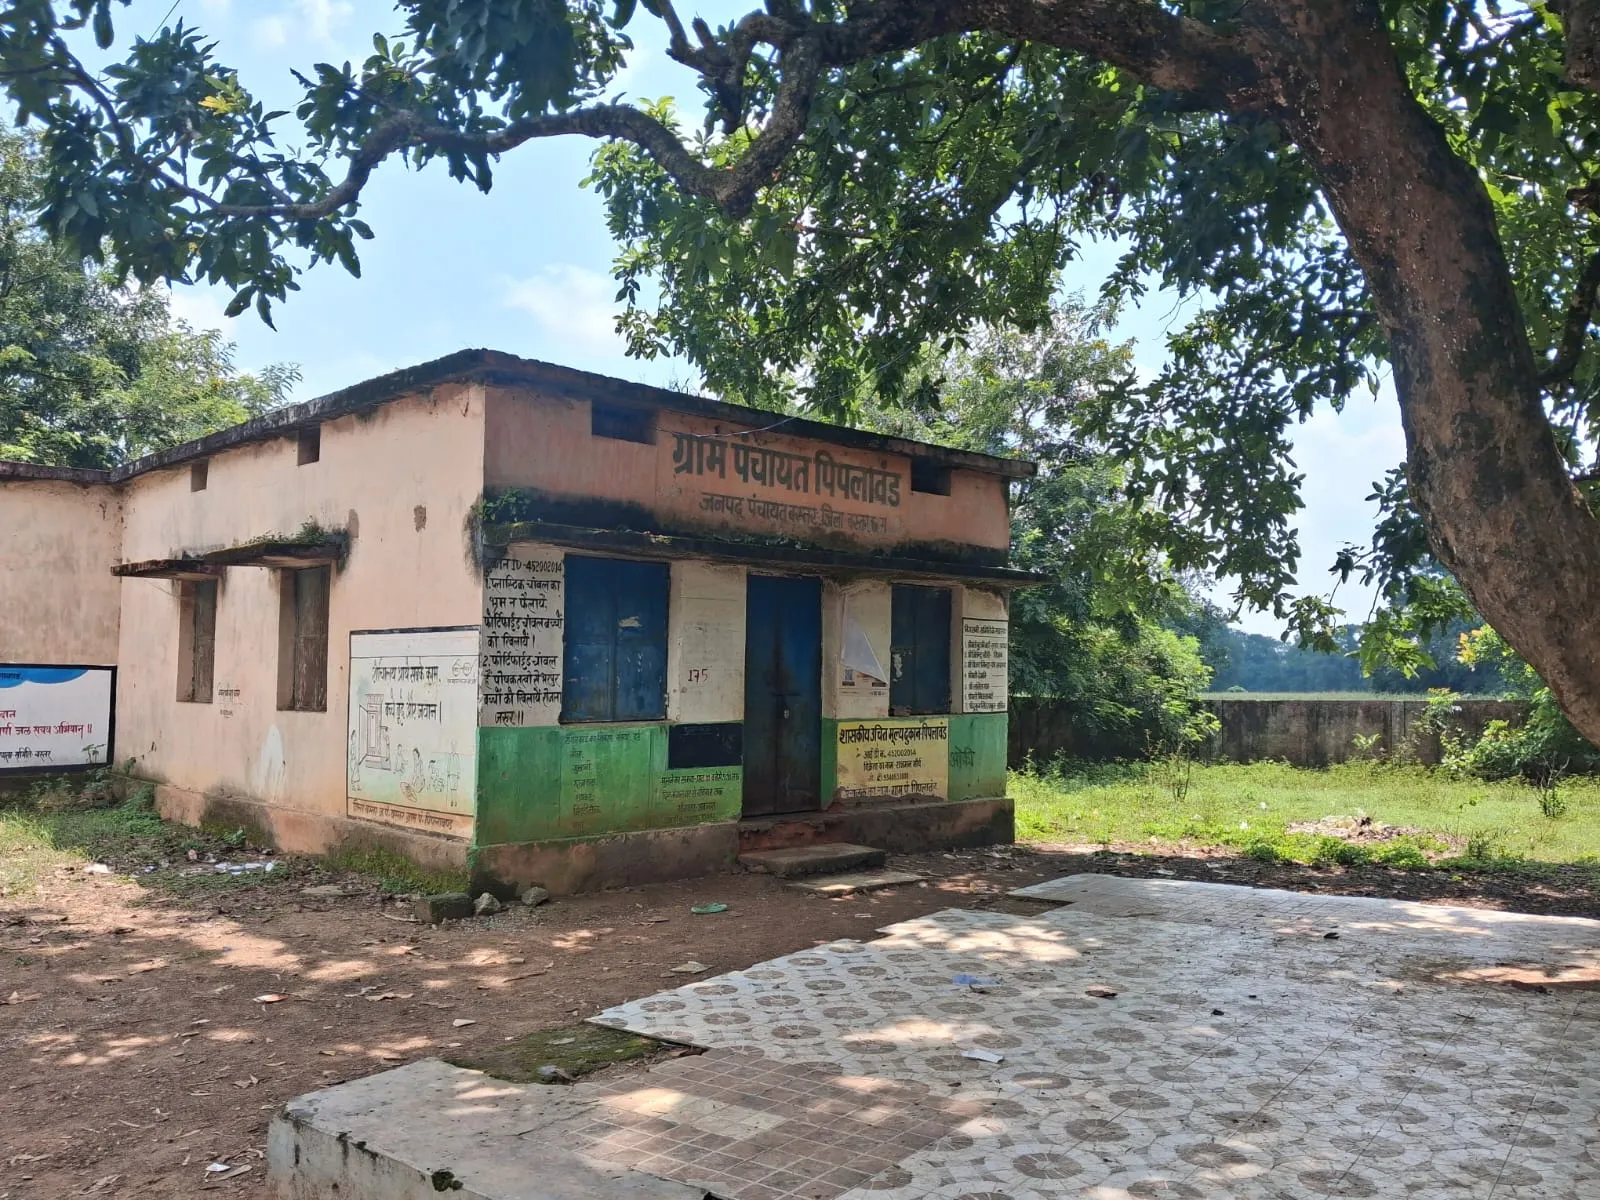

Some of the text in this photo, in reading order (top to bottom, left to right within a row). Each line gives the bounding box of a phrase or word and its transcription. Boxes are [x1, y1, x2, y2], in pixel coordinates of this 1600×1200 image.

[671, 432, 728, 480] ग्राम
[731, 432, 811, 493] पंचायत
[511, 559, 522, 571] ID
[550, 579, 561, 591] का
[508, 597, 517, 608] न
[486, 631, 500, 649] को
[688, 668, 710, 684] 175
[840, 725, 870, 744] शासकीय
[871, 724, 888, 742] उचित
[904, 726, 921, 745] दुकान
